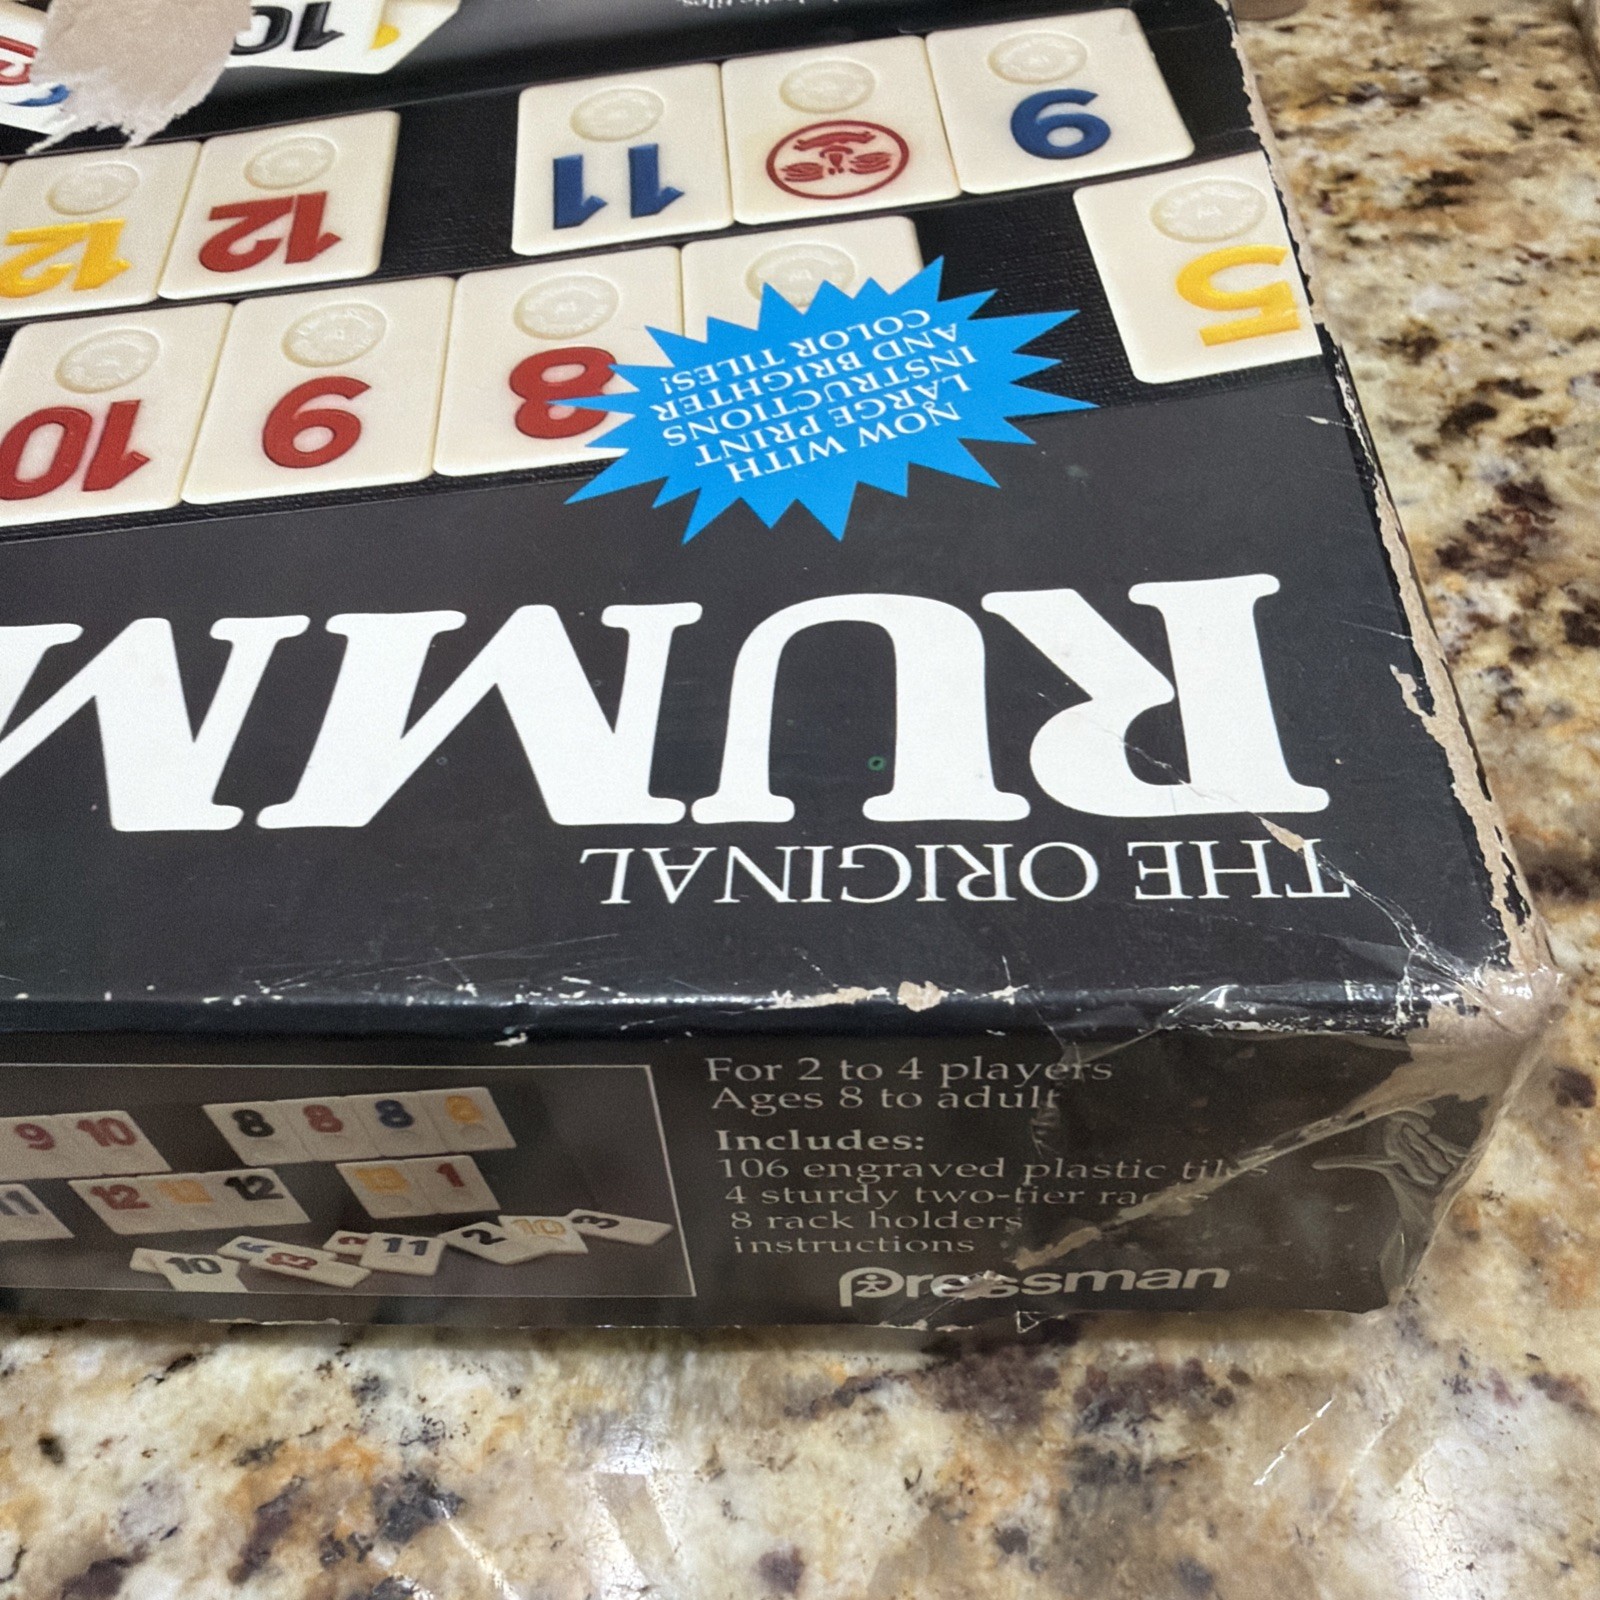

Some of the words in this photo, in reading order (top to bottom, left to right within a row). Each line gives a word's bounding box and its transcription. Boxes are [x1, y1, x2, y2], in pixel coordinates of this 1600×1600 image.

[553, 143, 685, 230] 11
[199, 191, 342, 272] 12
[1176, 243, 1302, 348] 5
[788, 308, 932, 360] COLOR
[872, 322, 959, 362] AND
[649, 350, 863, 423] BRIGHTER
[659, 349, 786, 395] TILES!
[509, 346, 618, 438] 8
[661, 344, 979, 447] INSTRUCTIONS
[825, 372, 973, 428] LARGE
[694, 413, 823, 467] PRINT
[858, 399, 962, 448] NOW
[0, 399, 150, 500] 10
[724, 435, 848, 484] WITH
[580, 841, 1099, 906] ORIGINAL
[1135, 838, 1351, 902] THE
[704, 1056, 783, 1082] For
[797, 1056, 824, 1081] 2
[839, 1059, 884, 1081] to
[897, 1056, 924, 1080] 4
[939, 1054, 1113, 1089] players
[303, 1104, 344, 1134] 8
[374, 1099, 414, 1129] 8
[711, 1086, 824, 1117] Ages
[839, 1085, 863, 1109] 8
[880, 1087, 924, 1109] to
[936, 1085, 1061, 1109] adult
[13, 1123, 55, 1151] 9
[76, 1117, 138, 1148] 10
[231, 1108, 275, 1138] 8
[715, 1129, 926, 1151] Includes:
[224, 1175, 285, 1202] 12
[436, 1162, 465, 1188] 1
[719, 1157, 790, 1179] 106
[802, 1157, 1006, 1184] engraved
[1023, 1157, 1166, 1187] plastic
[724, 1185, 747, 1204] 4
[760, 1183, 899, 1210] sturdy
[915, 1185, 1084, 1206] two-tier
[730, 1210, 753, 1230] 8
[766, 1210, 855, 1230] rack
[868, 1209, 1023, 1231] holders
[382, 1236, 430, 1257] 11
[733, 1235, 976, 1254] instructions
[165, 1256, 222, 1275] 10
